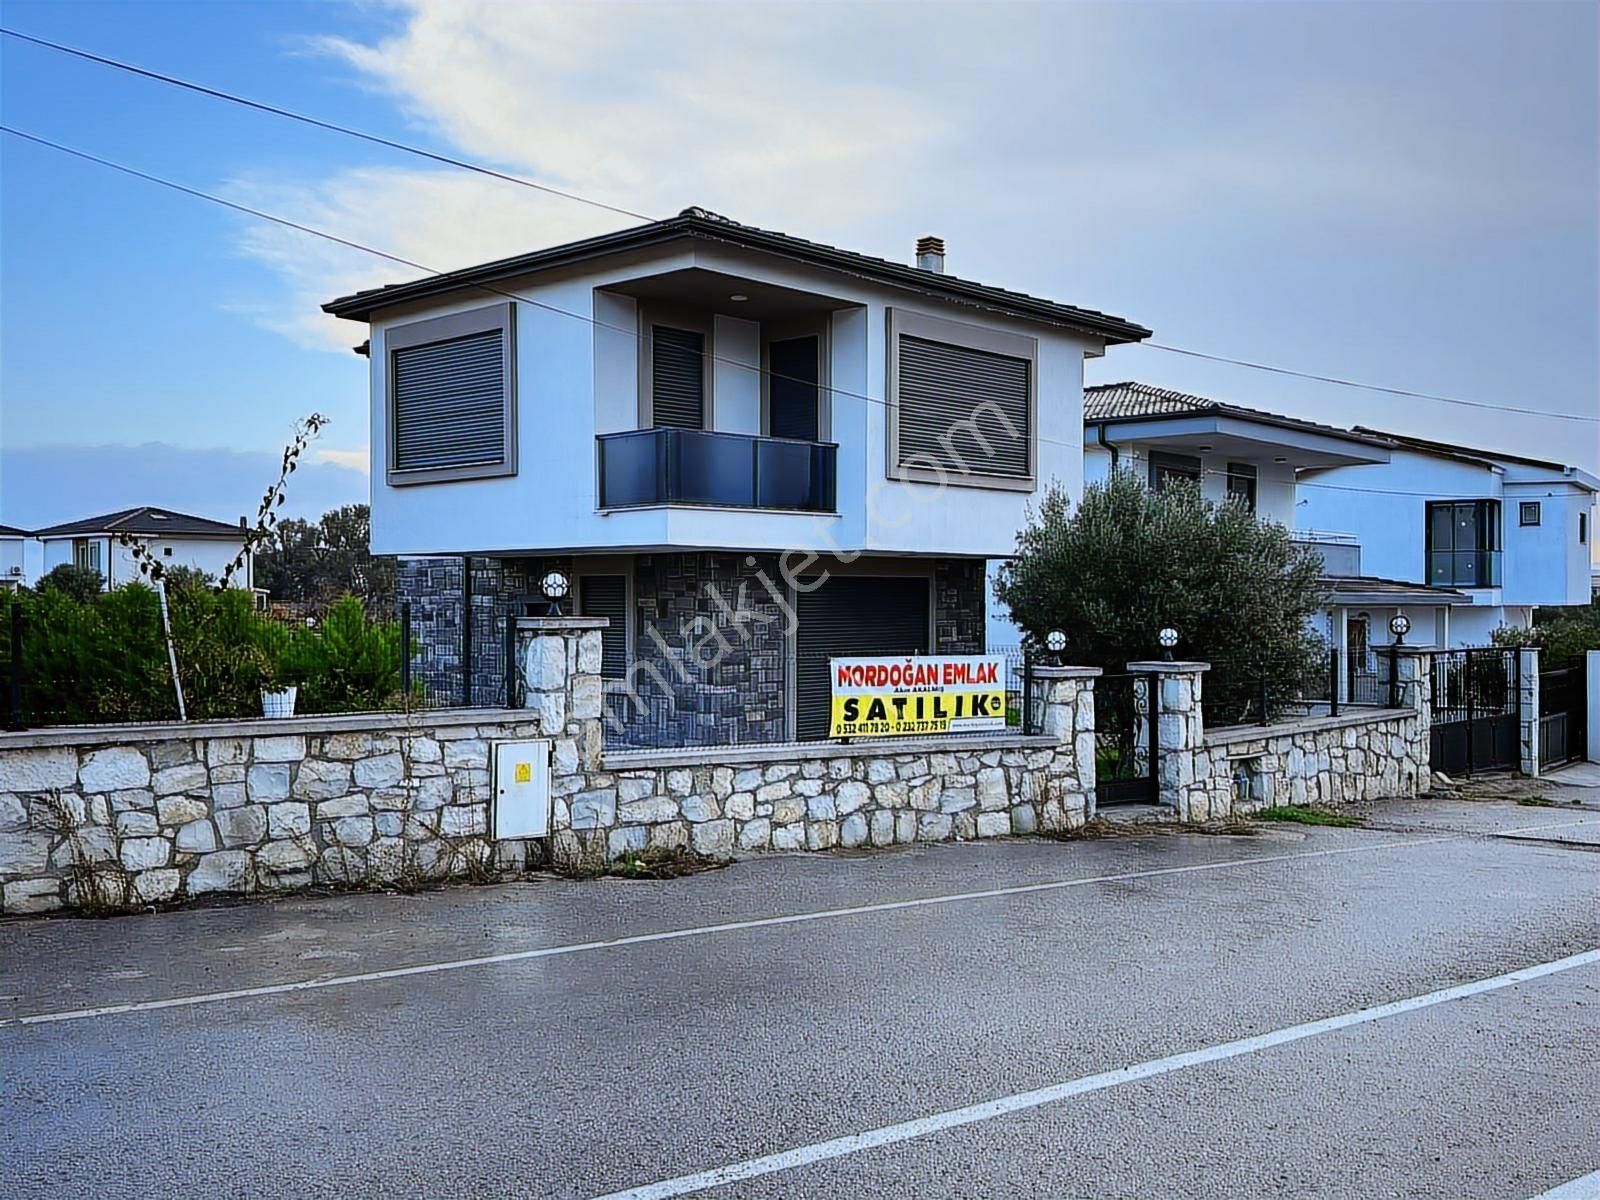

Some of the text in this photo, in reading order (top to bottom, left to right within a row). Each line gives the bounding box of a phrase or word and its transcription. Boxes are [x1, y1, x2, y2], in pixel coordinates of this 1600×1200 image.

[837, 658, 999, 688] MORDOĞAN EMLAK
[843, 694, 990, 722] SATILIK
[843, 723, 857, 734] 532
